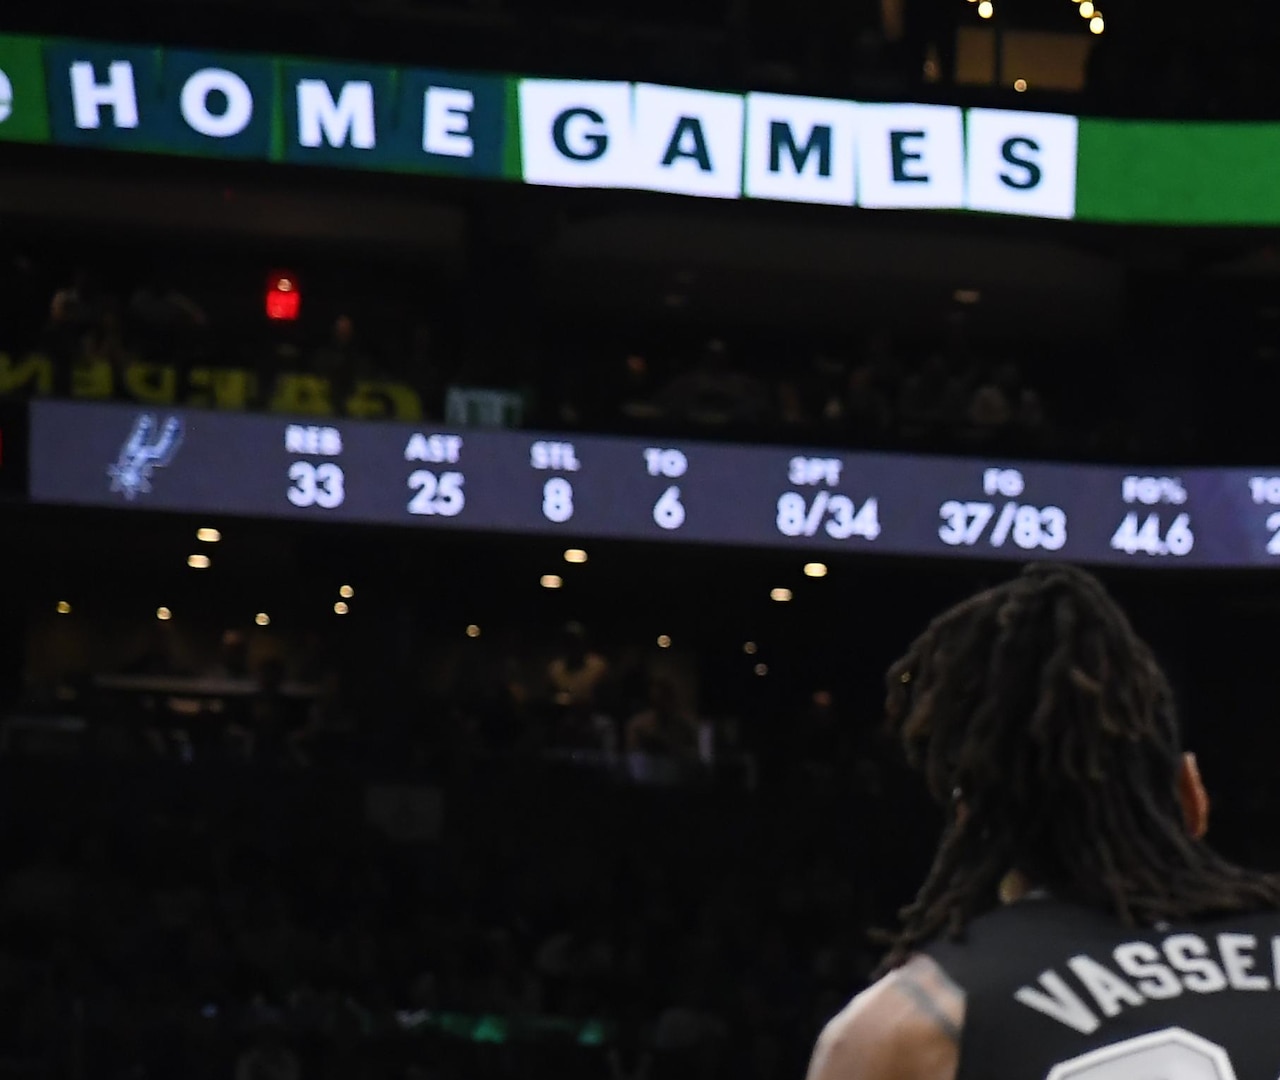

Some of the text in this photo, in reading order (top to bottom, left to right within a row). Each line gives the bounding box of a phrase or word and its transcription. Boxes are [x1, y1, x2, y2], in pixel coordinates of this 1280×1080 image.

[71, 62, 473, 157] HOME
[552, 107, 1042, 191] GAMES
[284, 424, 343, 457] REB
[404, 433, 462, 464] AST
[530, 440, 579, 472] STL
[644, 447, 688, 478] TO
[287, 460, 345, 509] 33
[407, 469, 465, 517] 25
[541, 477, 574, 523] 8
[983, 467, 1025, 498] FG
[1122, 475, 1188, 506] FG%
[652, 485, 686, 530] 6
[775, 490, 882, 542] 8/34
[937, 500, 1068, 551] 37/83
[1110, 513, 1195, 557] 44.6
